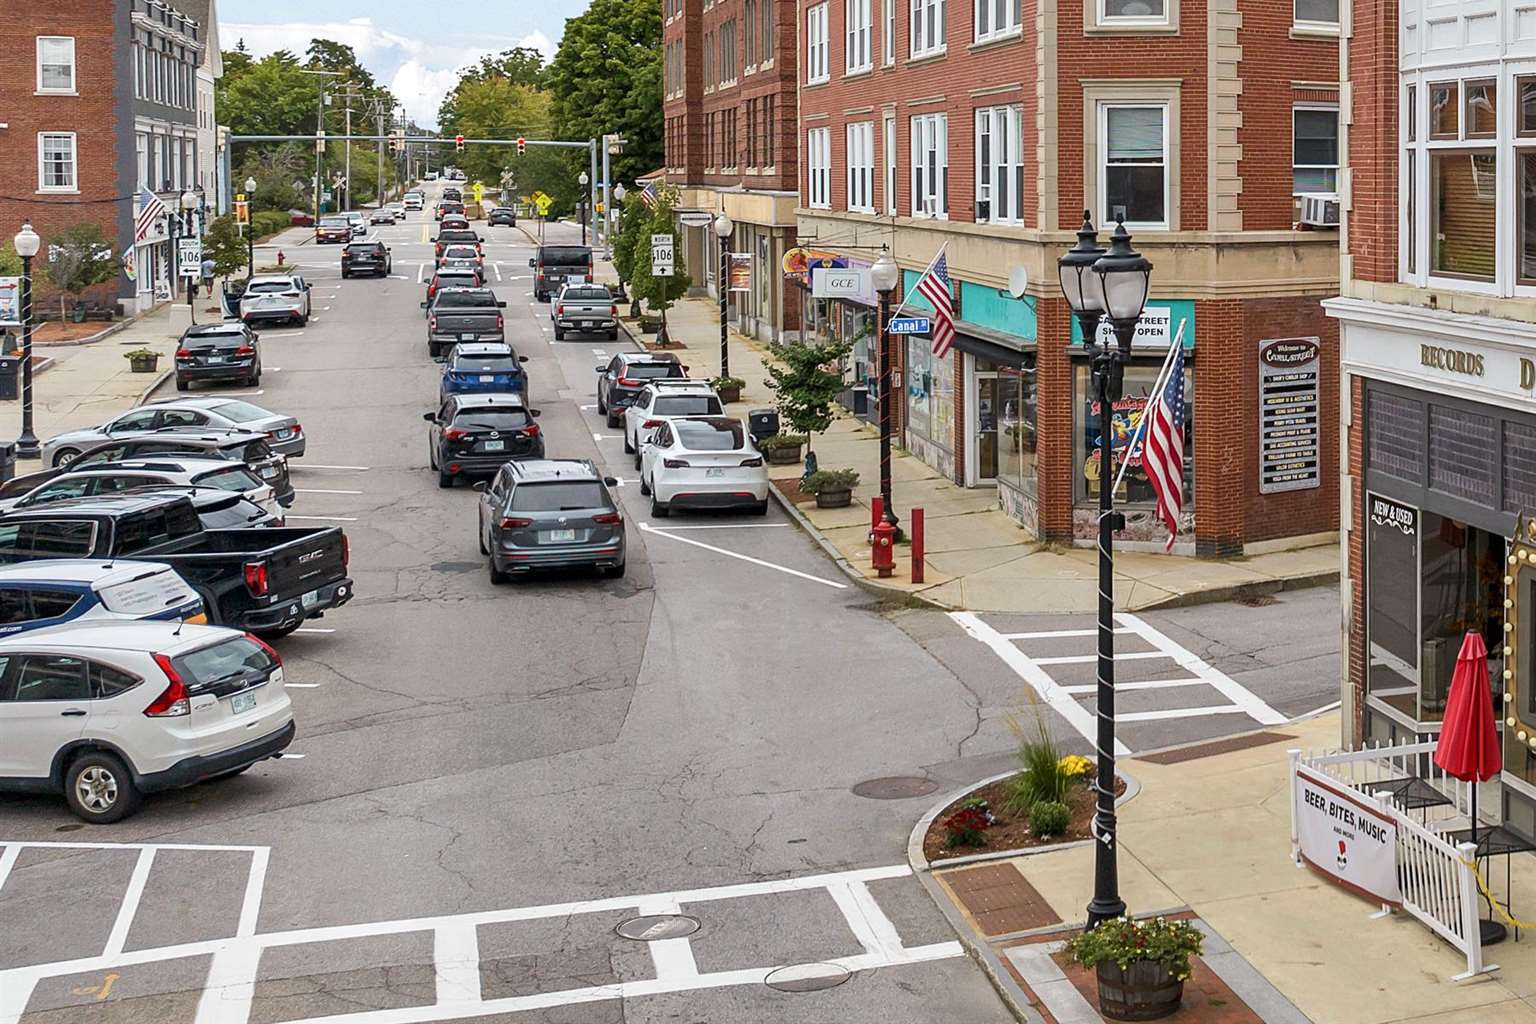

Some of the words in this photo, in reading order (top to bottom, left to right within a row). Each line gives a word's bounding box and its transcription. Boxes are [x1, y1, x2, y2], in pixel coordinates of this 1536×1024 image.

[183, 252, 199, 262] 106
[656, 249, 672, 260] 106
[831, 279, 854, 288] GCE
[892, 320, 918, 331] Canal
[1138, 317, 1169, 325] TREET
[1137, 328, 1164, 336] OPEN
[1420, 344, 1485, 377] RECORDS
[1374, 500, 1390, 517] NEW
[1389, 505, 1395, 519] &
[1396, 507, 1413, 526] USED
[1304, 788, 1328, 815] BEER,
[1329, 802, 1357, 830] BITES,
[1358, 816, 1387, 844] MUSIC
